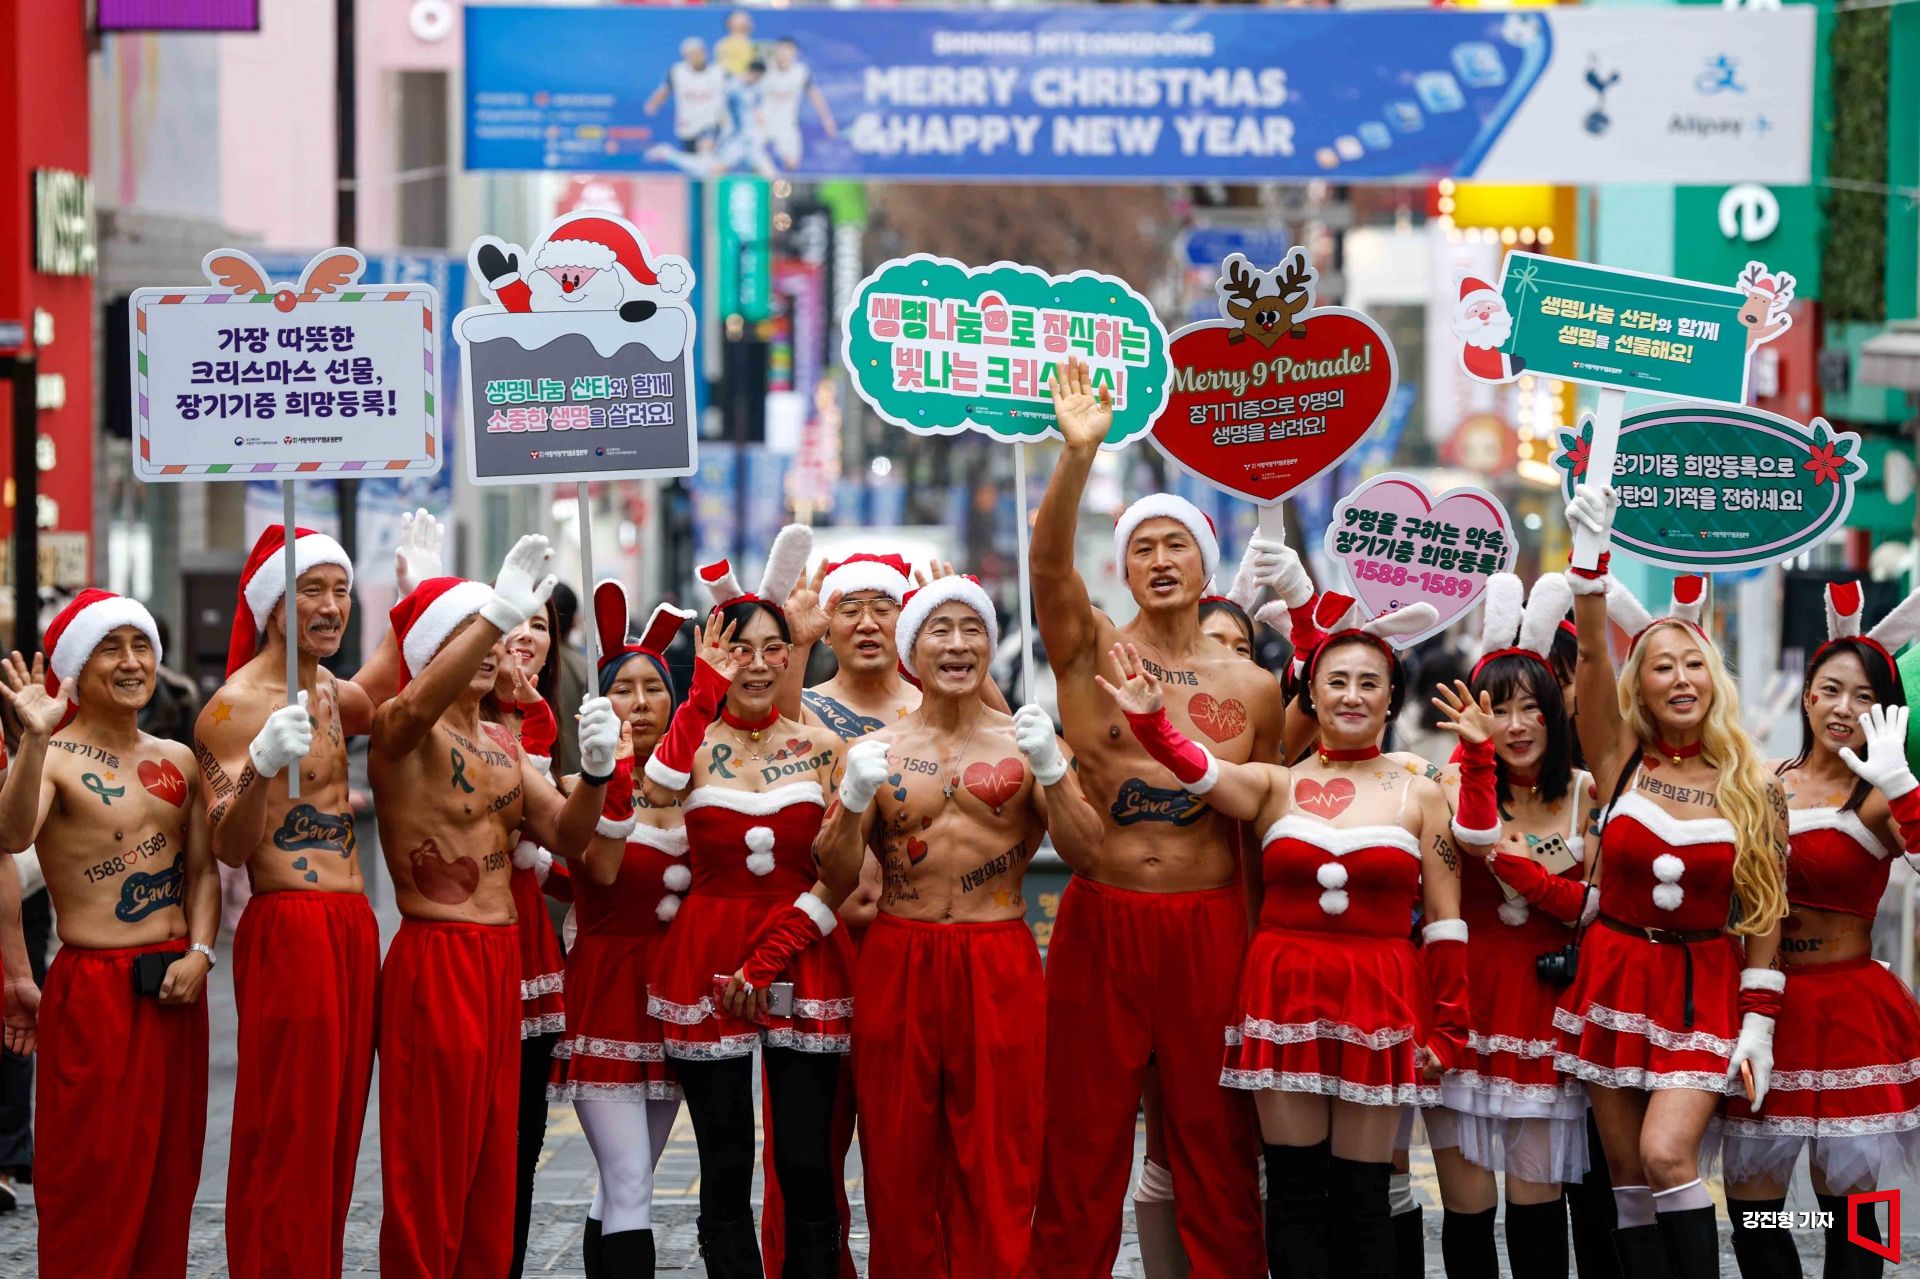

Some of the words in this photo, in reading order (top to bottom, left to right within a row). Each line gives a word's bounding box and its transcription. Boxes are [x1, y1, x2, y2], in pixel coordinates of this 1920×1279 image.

[864, 66, 1016, 107] MERRY
[1029, 66, 1287, 107] CHRISTMAS
[851, 113, 1041, 156] &HAPPY
[1054, 114, 1163, 156] NEW
[1174, 114, 1296, 156] YEAR
[871, 295, 1036, 348] 생명나눔으로
[1042, 312, 1146, 364] 장식하는
[1541, 295, 1615, 325] 생명나눔
[1619, 308, 1672, 334] 산타와
[1677, 317, 1720, 342] 함께
[217, 327, 269, 353] 가장
[277, 325, 355, 352] 따뜻한
[1558, 325, 1610, 350] 생명을
[1615, 334, 1694, 364] 선물해요!
[190, 360, 317, 386] 크리스마스
[324, 357, 383, 386] 선물,
[896, 347, 978, 392] 빛나는
[1169, 365, 1249, 397] Merry
[1253, 362, 1267, 385] 9
[1271, 345, 1371, 384] Parade!
[176, 393, 277, 420] 장기기증
[285, 390, 398, 418] 희망등록!
[486, 377, 565, 404] 생명나눔
[571, 375, 627, 399] 산타와
[632, 373, 673, 398] 함께
[487, 407, 549, 433] 소중한
[550, 405, 606, 430] 생명을
[609, 402, 674, 427] 살려요!
[1189, 396, 1296, 425] 장기기증으로
[1298, 389, 1344, 412] 9명의
[1212, 424, 1265, 446] 생명을
[1268, 416, 1326, 439] 살려요!
[1684, 454, 1796, 479] 희망등록으로
[1663, 486, 1717, 511] 기적을
[1721, 488, 1803, 512] 전하세요!
[1345, 507, 1398, 536] 9명을
[1401, 517, 1460, 546] 구하는
[1466, 526, 1508, 556] 약속,
[1336, 530, 1415, 563] 장기기증
[1418, 544, 1506, 577] 희망등록!
[1354, 558, 1473, 599] 1588-1589
[760, 749, 833, 785] Donor
[903, 757, 938, 776] 1589
[1118, 791, 1189, 818] Save
[283, 816, 343, 843] Save
[84, 857, 126, 884] 1588
[135, 832, 167, 859] 1589
[482, 850, 505, 872] 1588
[1433, 834, 1457, 872] 1588
[127, 880, 178, 915] Save
